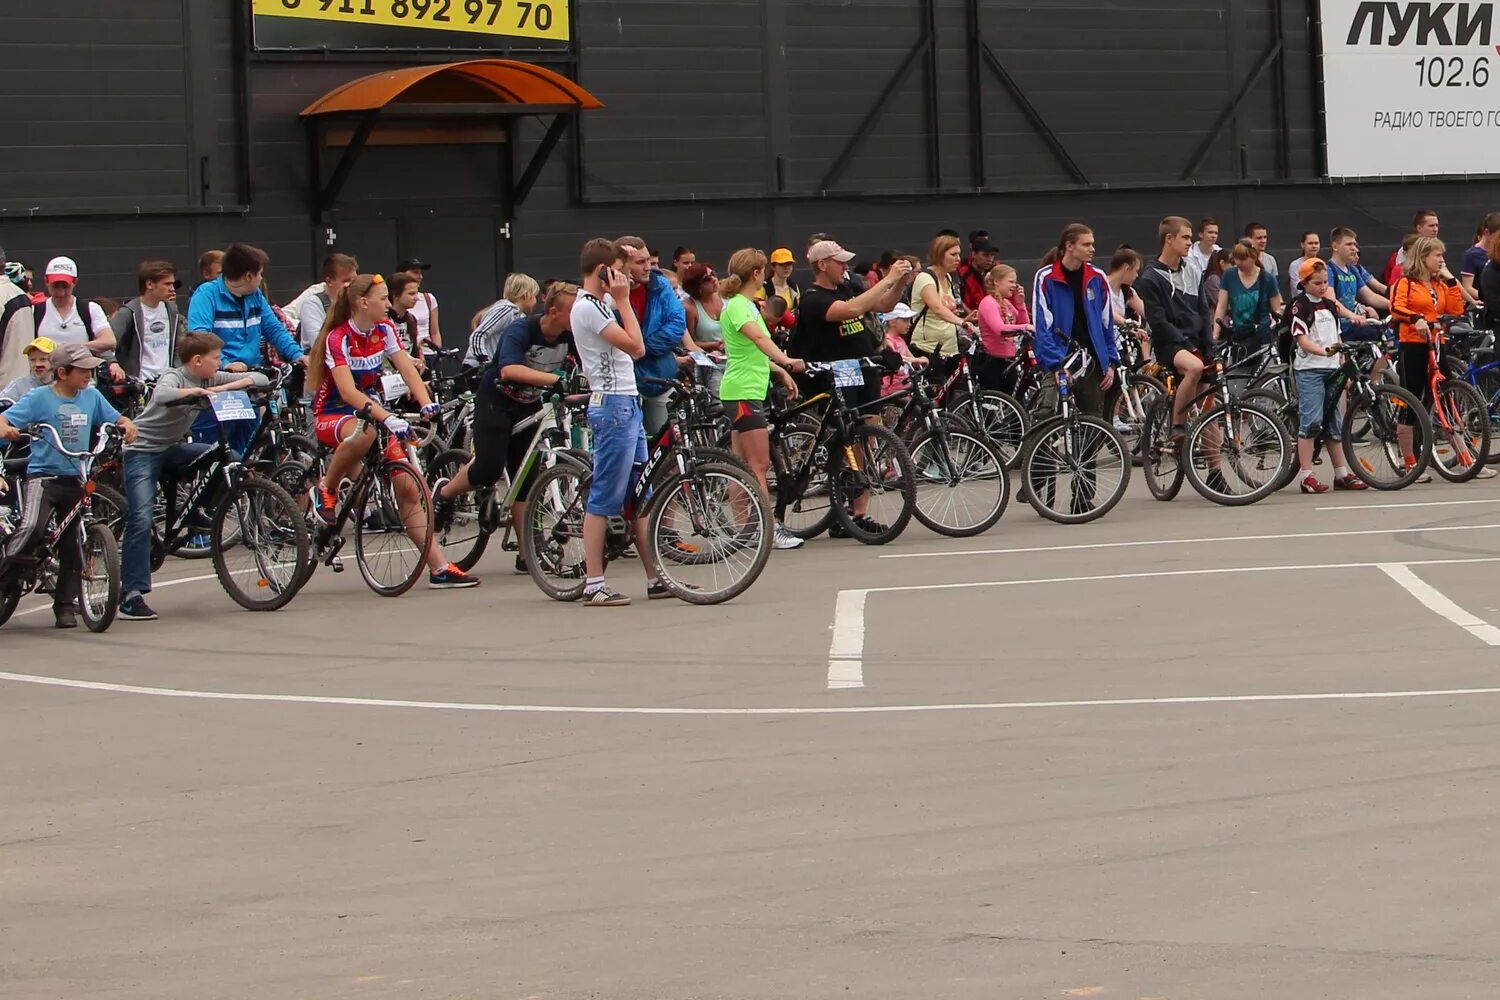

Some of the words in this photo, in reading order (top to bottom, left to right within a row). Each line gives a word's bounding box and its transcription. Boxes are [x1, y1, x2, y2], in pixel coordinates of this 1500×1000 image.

[516, 1, 552, 31] 70
[1415, 56, 1489, 87] 102.6
[1373, 111, 1423, 131] РАДИО
[1428, 111, 1483, 127] ТВОЕГО
[635, 447, 663, 498] STELS
